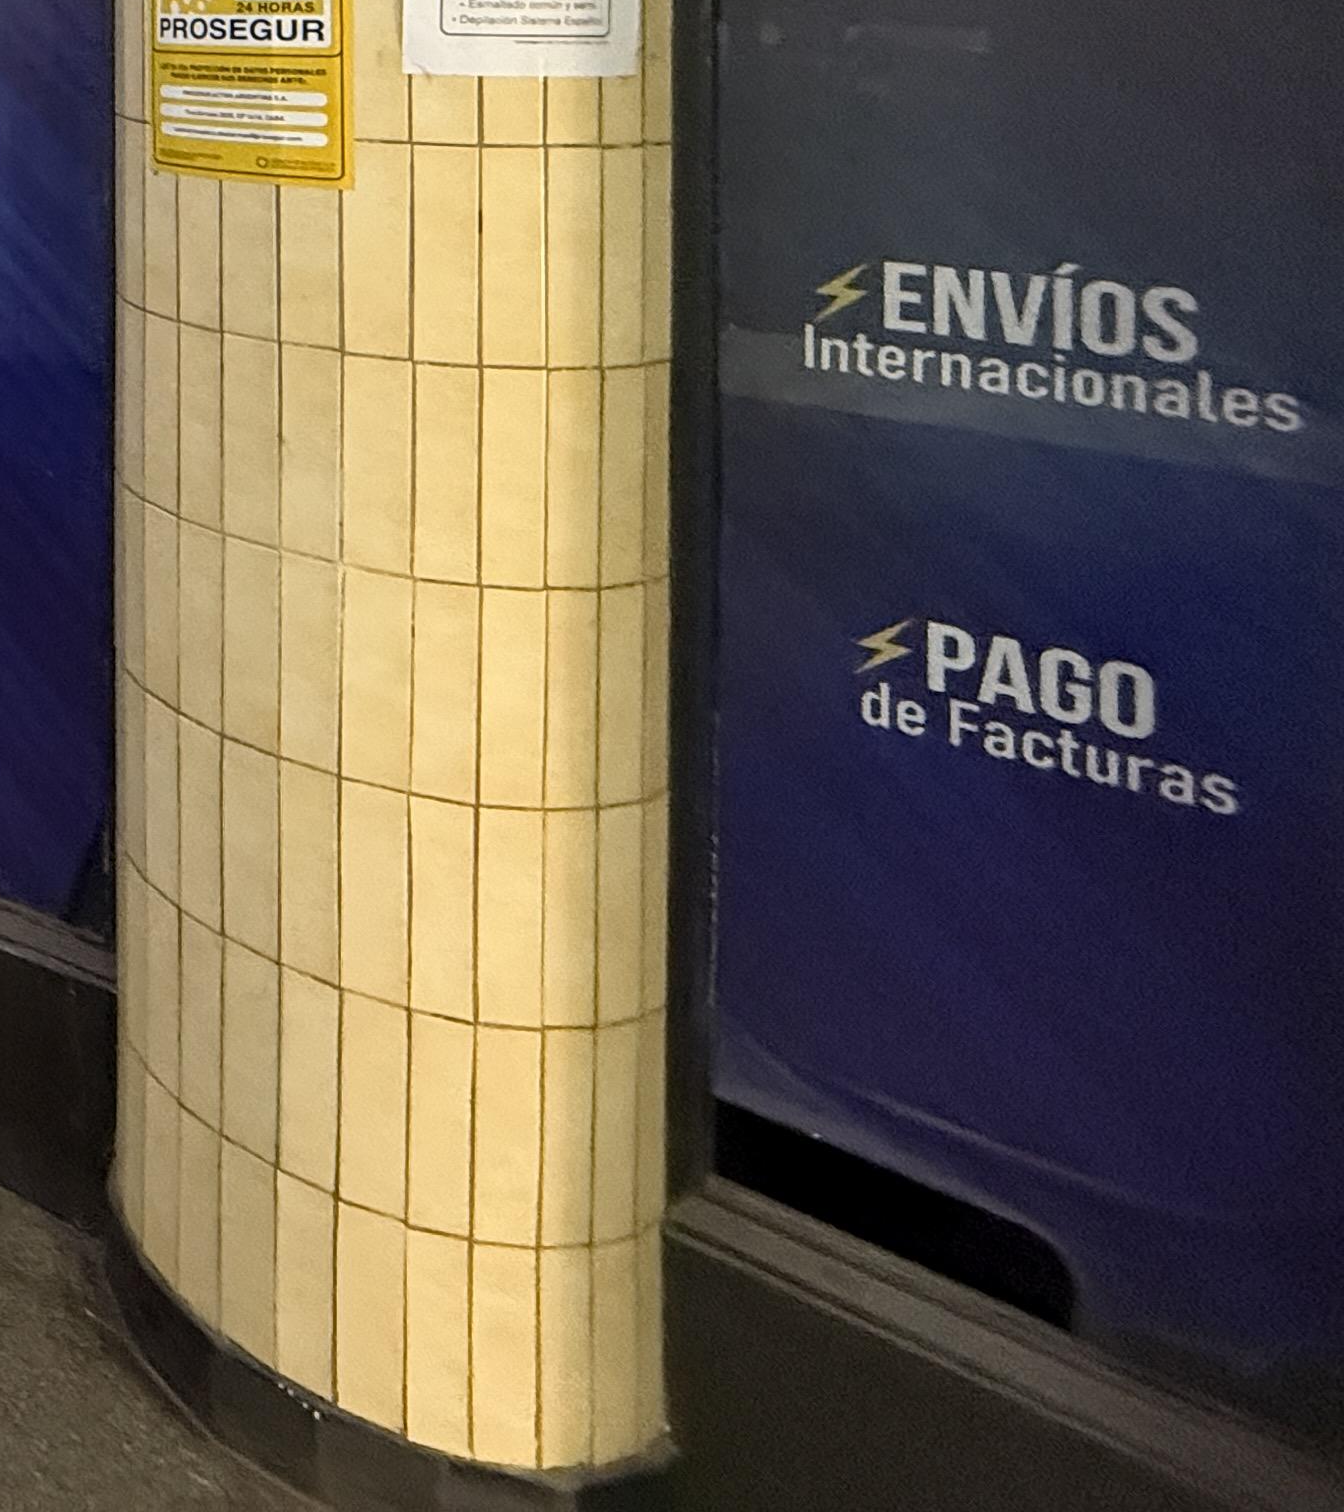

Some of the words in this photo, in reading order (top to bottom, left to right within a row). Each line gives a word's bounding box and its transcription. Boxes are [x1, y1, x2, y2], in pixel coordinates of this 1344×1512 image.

[160, 17, 324, 41] PROSEGUR
[236, 2, 253, 13] 24
[258, 2, 315, 13] HORAS
[883, 262, 1200, 363] ENVÍOS
[803, 324, 1306, 432] Internacionales
[927, 620, 1156, 739] PAGO
[860, 683, 927, 736] de
[948, 700, 1241, 814] Facturas
